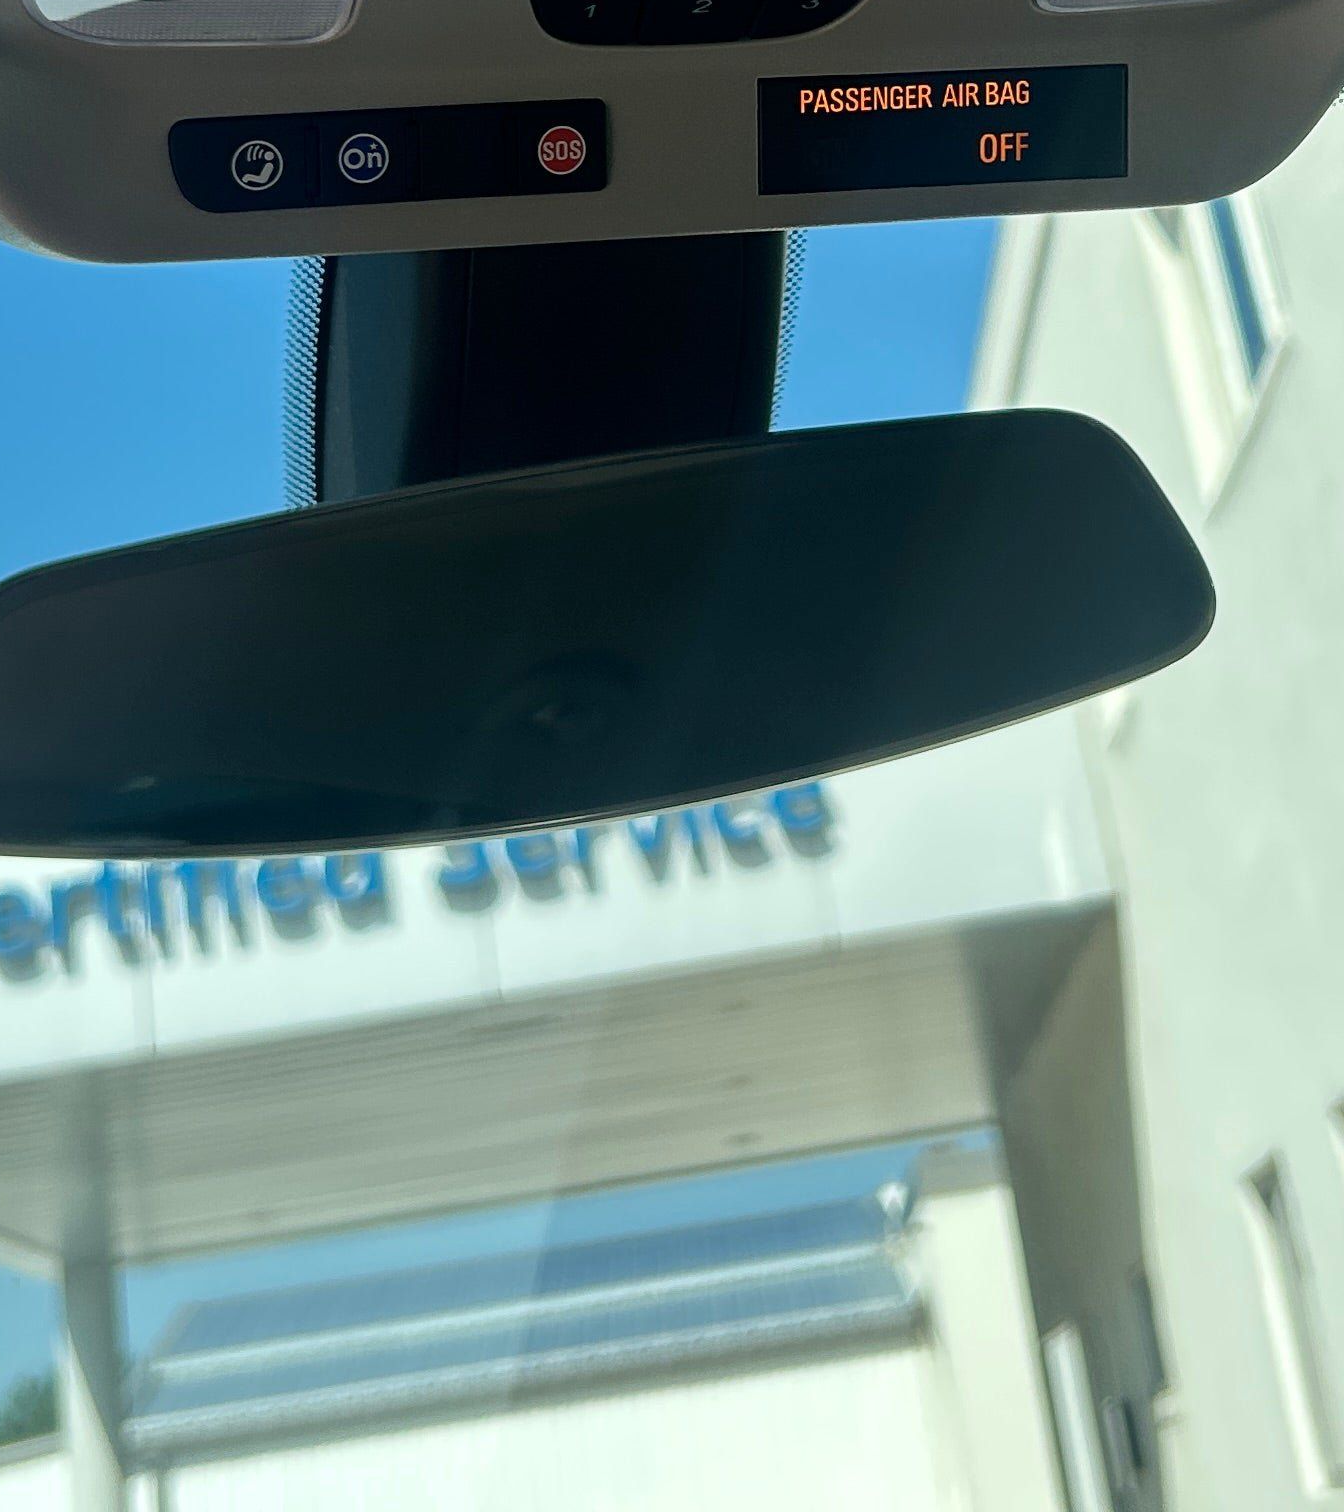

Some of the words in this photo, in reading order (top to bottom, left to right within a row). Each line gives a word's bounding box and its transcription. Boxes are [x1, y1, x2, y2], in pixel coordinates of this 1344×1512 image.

[583, 4, 598, 18] 1
[692, 0, 713, 13] 2
[800, 84, 932, 114] PASSENGER
[942, 82, 979, 108] AIR
[985, 80, 1030, 106] BAG
[542, 140, 582, 161] SOS
[979, 132, 1030, 164] OFF
